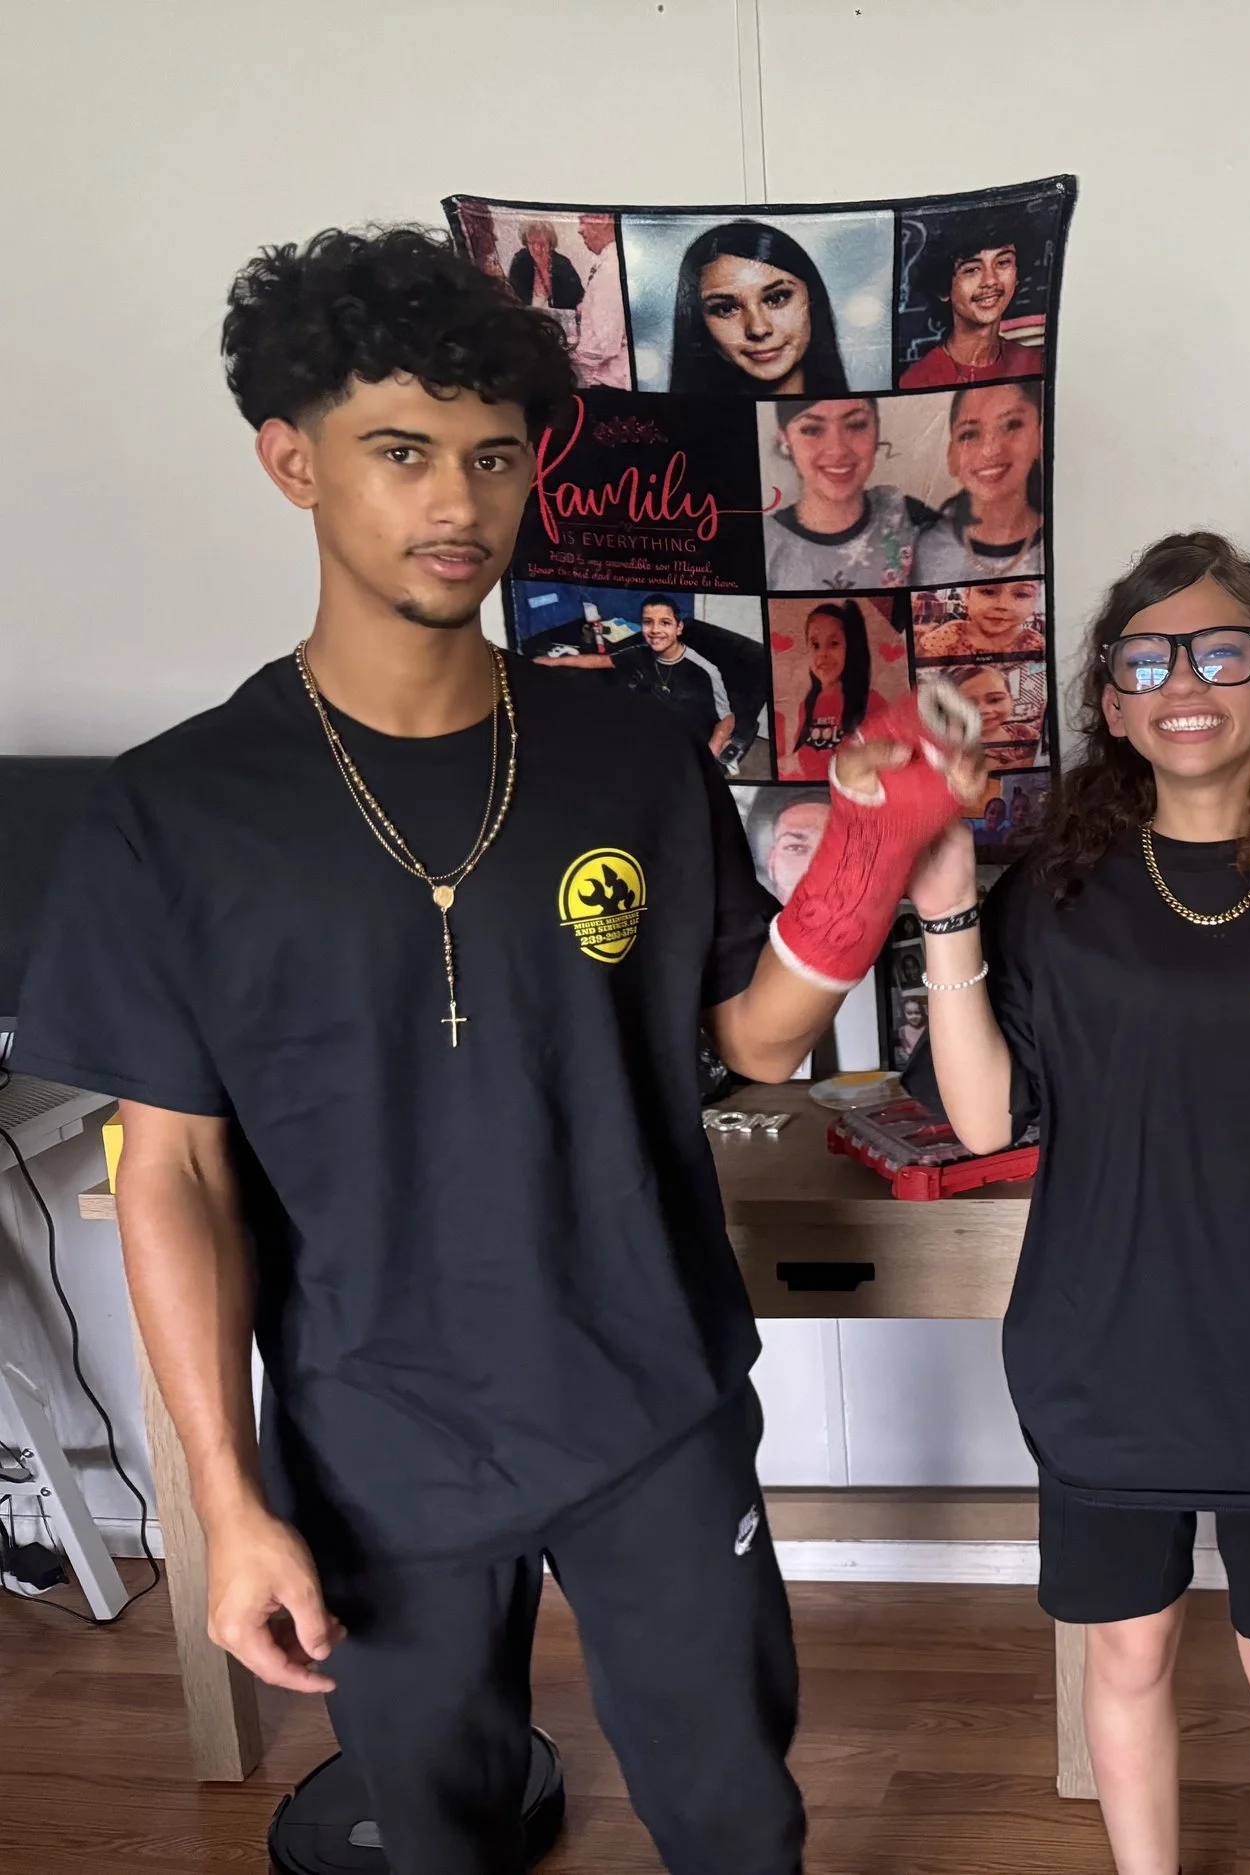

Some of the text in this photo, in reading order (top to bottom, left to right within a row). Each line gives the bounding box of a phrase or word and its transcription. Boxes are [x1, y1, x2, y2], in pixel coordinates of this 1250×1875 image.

[531, 394, 781, 544] Family
[562, 530, 697, 553] IS EVERYTHING
[648, 573, 676, 585] would
[679, 574, 699, 586] love
[573, 920, 605, 930] MIGUEL
[575, 927, 596, 937] AND
